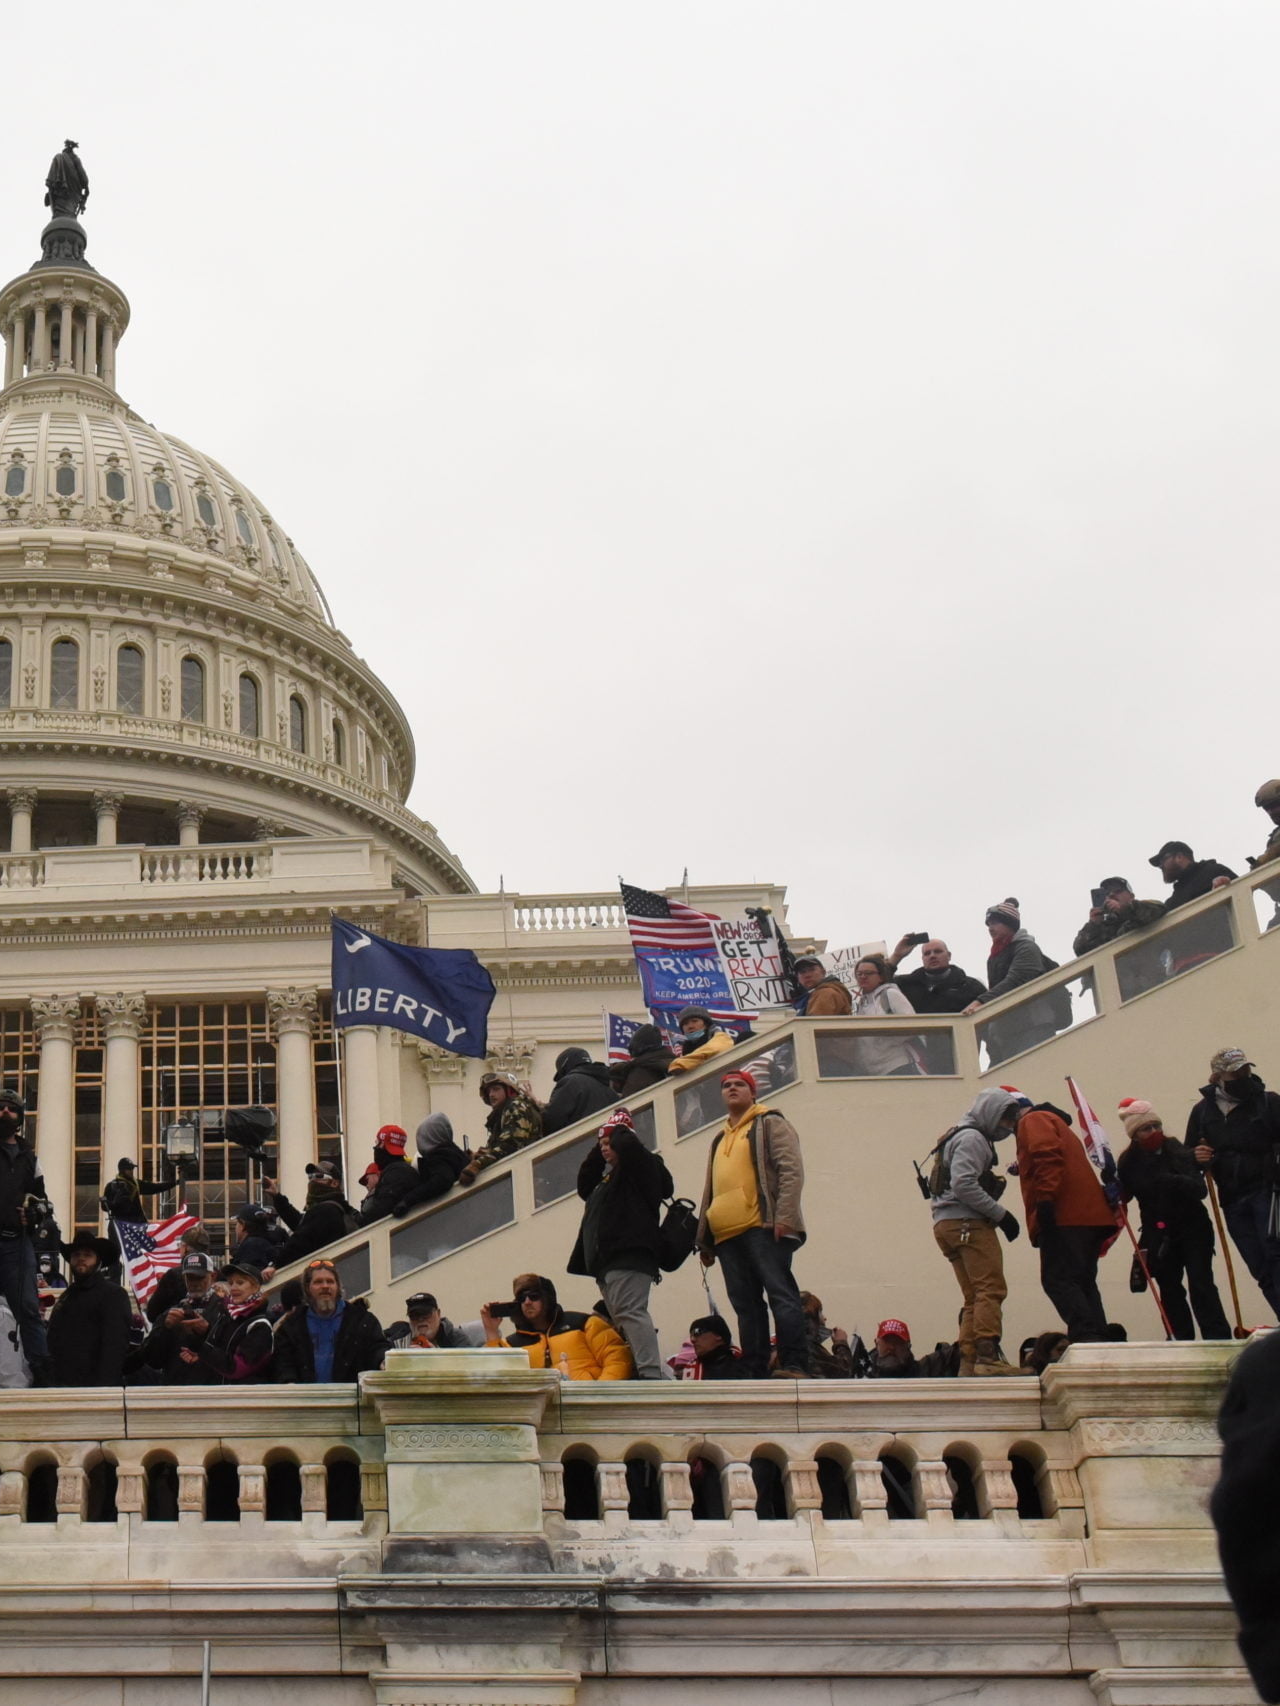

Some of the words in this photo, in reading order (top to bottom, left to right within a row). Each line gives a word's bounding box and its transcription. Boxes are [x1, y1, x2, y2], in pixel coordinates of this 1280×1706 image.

[721, 940, 767, 958] GET
[655, 991, 676, 999] KEEP
[677, 990, 711, 1000] AMERICA
[712, 990, 731, 999] GREA
[336, 987, 466, 1044] LIBERTY
